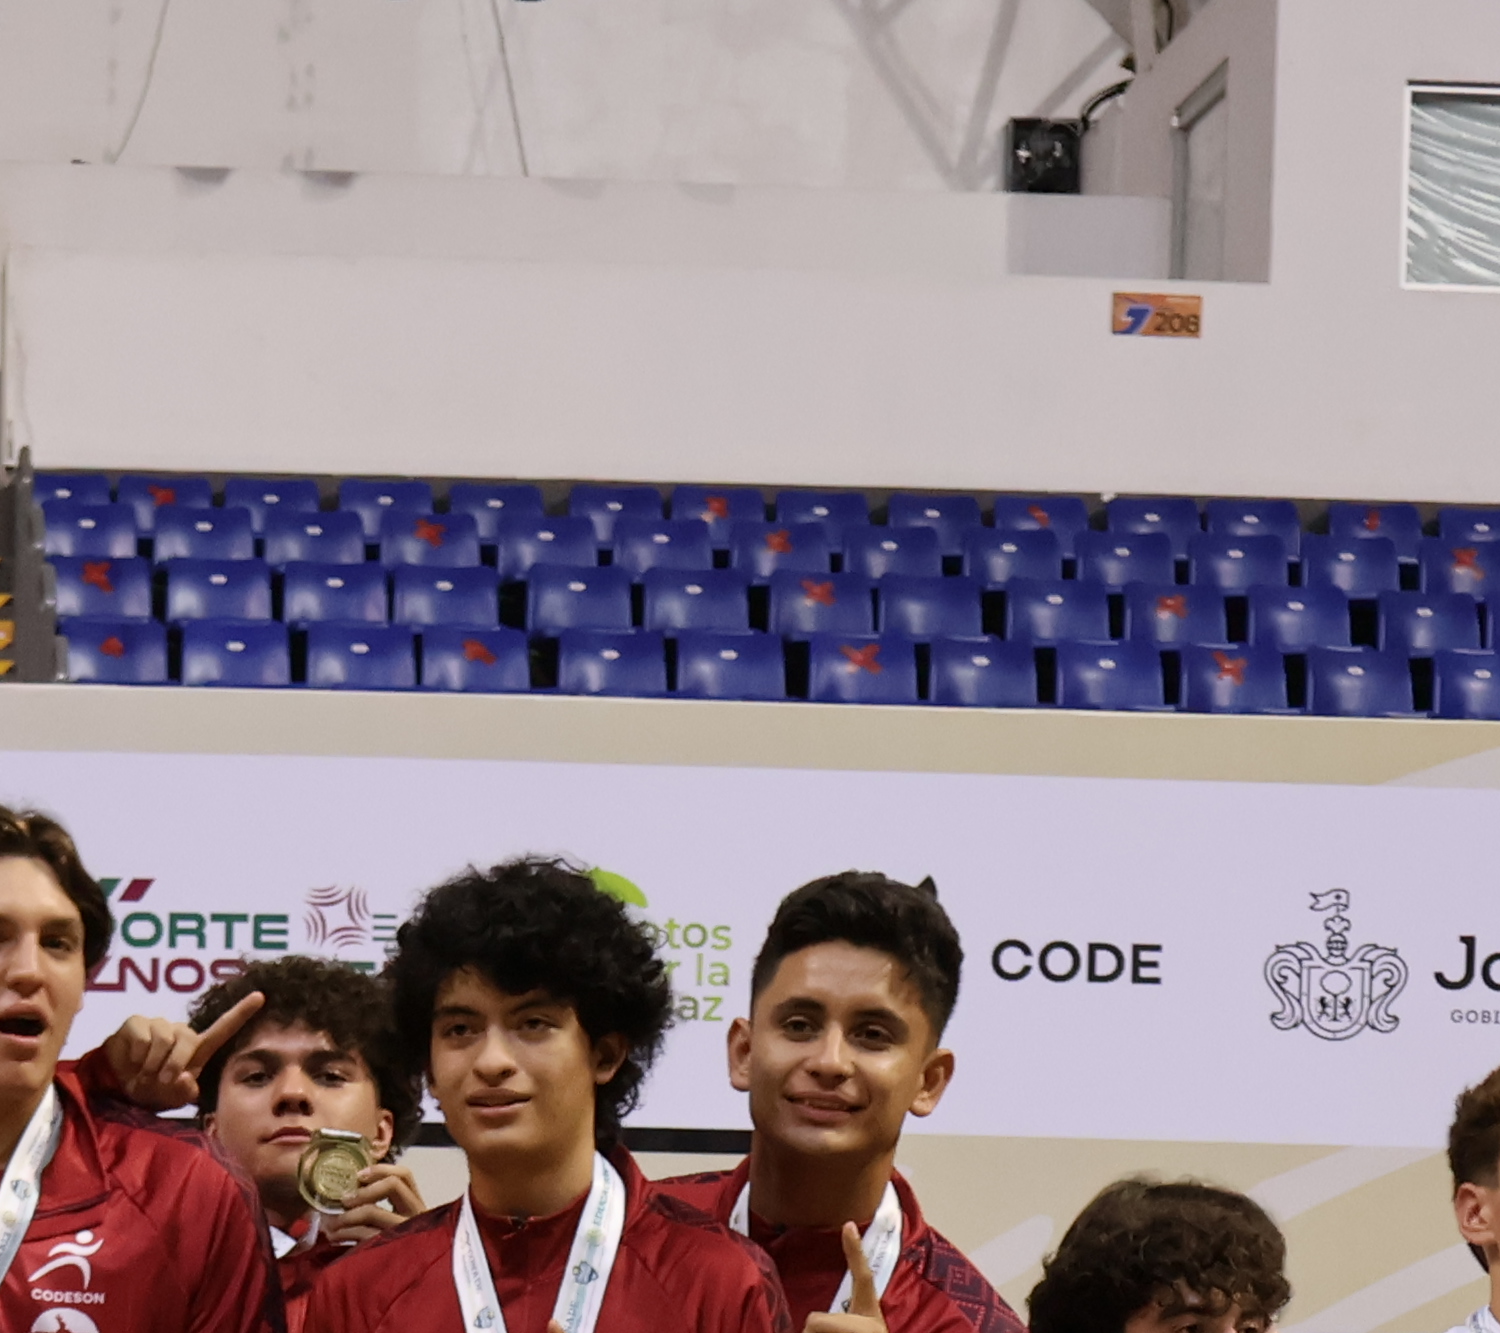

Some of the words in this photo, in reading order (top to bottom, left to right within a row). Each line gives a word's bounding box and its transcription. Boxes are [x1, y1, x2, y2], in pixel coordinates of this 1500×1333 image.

[1153, 311, 1201, 335] 208
[118, 912, 290, 950] ORTE
[696, 953, 730, 988] la
[990, 939, 1163, 985] CODE
[679, 996, 724, 1022] az
[30, 1287, 106, 1305] CODESON
